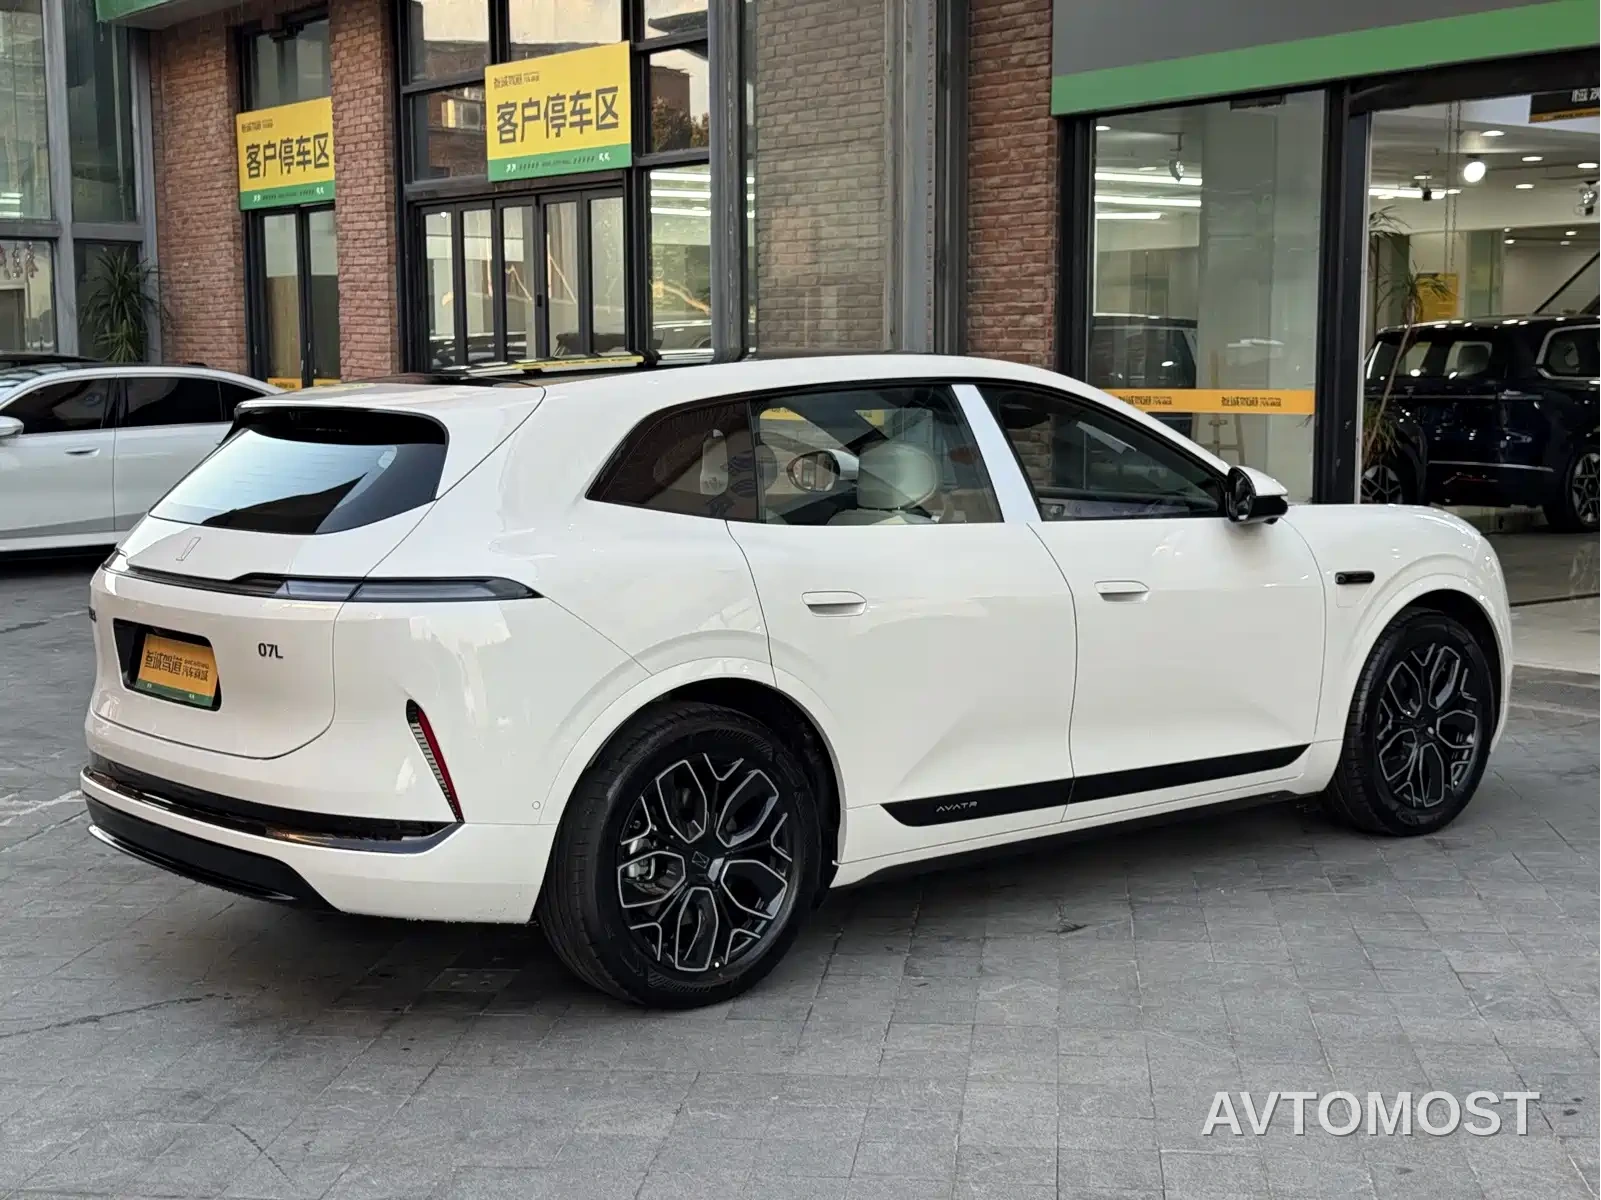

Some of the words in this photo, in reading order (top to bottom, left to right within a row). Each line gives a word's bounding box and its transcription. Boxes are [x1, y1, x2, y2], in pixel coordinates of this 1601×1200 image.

[497, 86, 619, 144] 客户停车区
[246, 132, 330, 179] 客户停车区
[258, 642, 284, 659] 07L
[936, 801, 978, 812] AVATR
